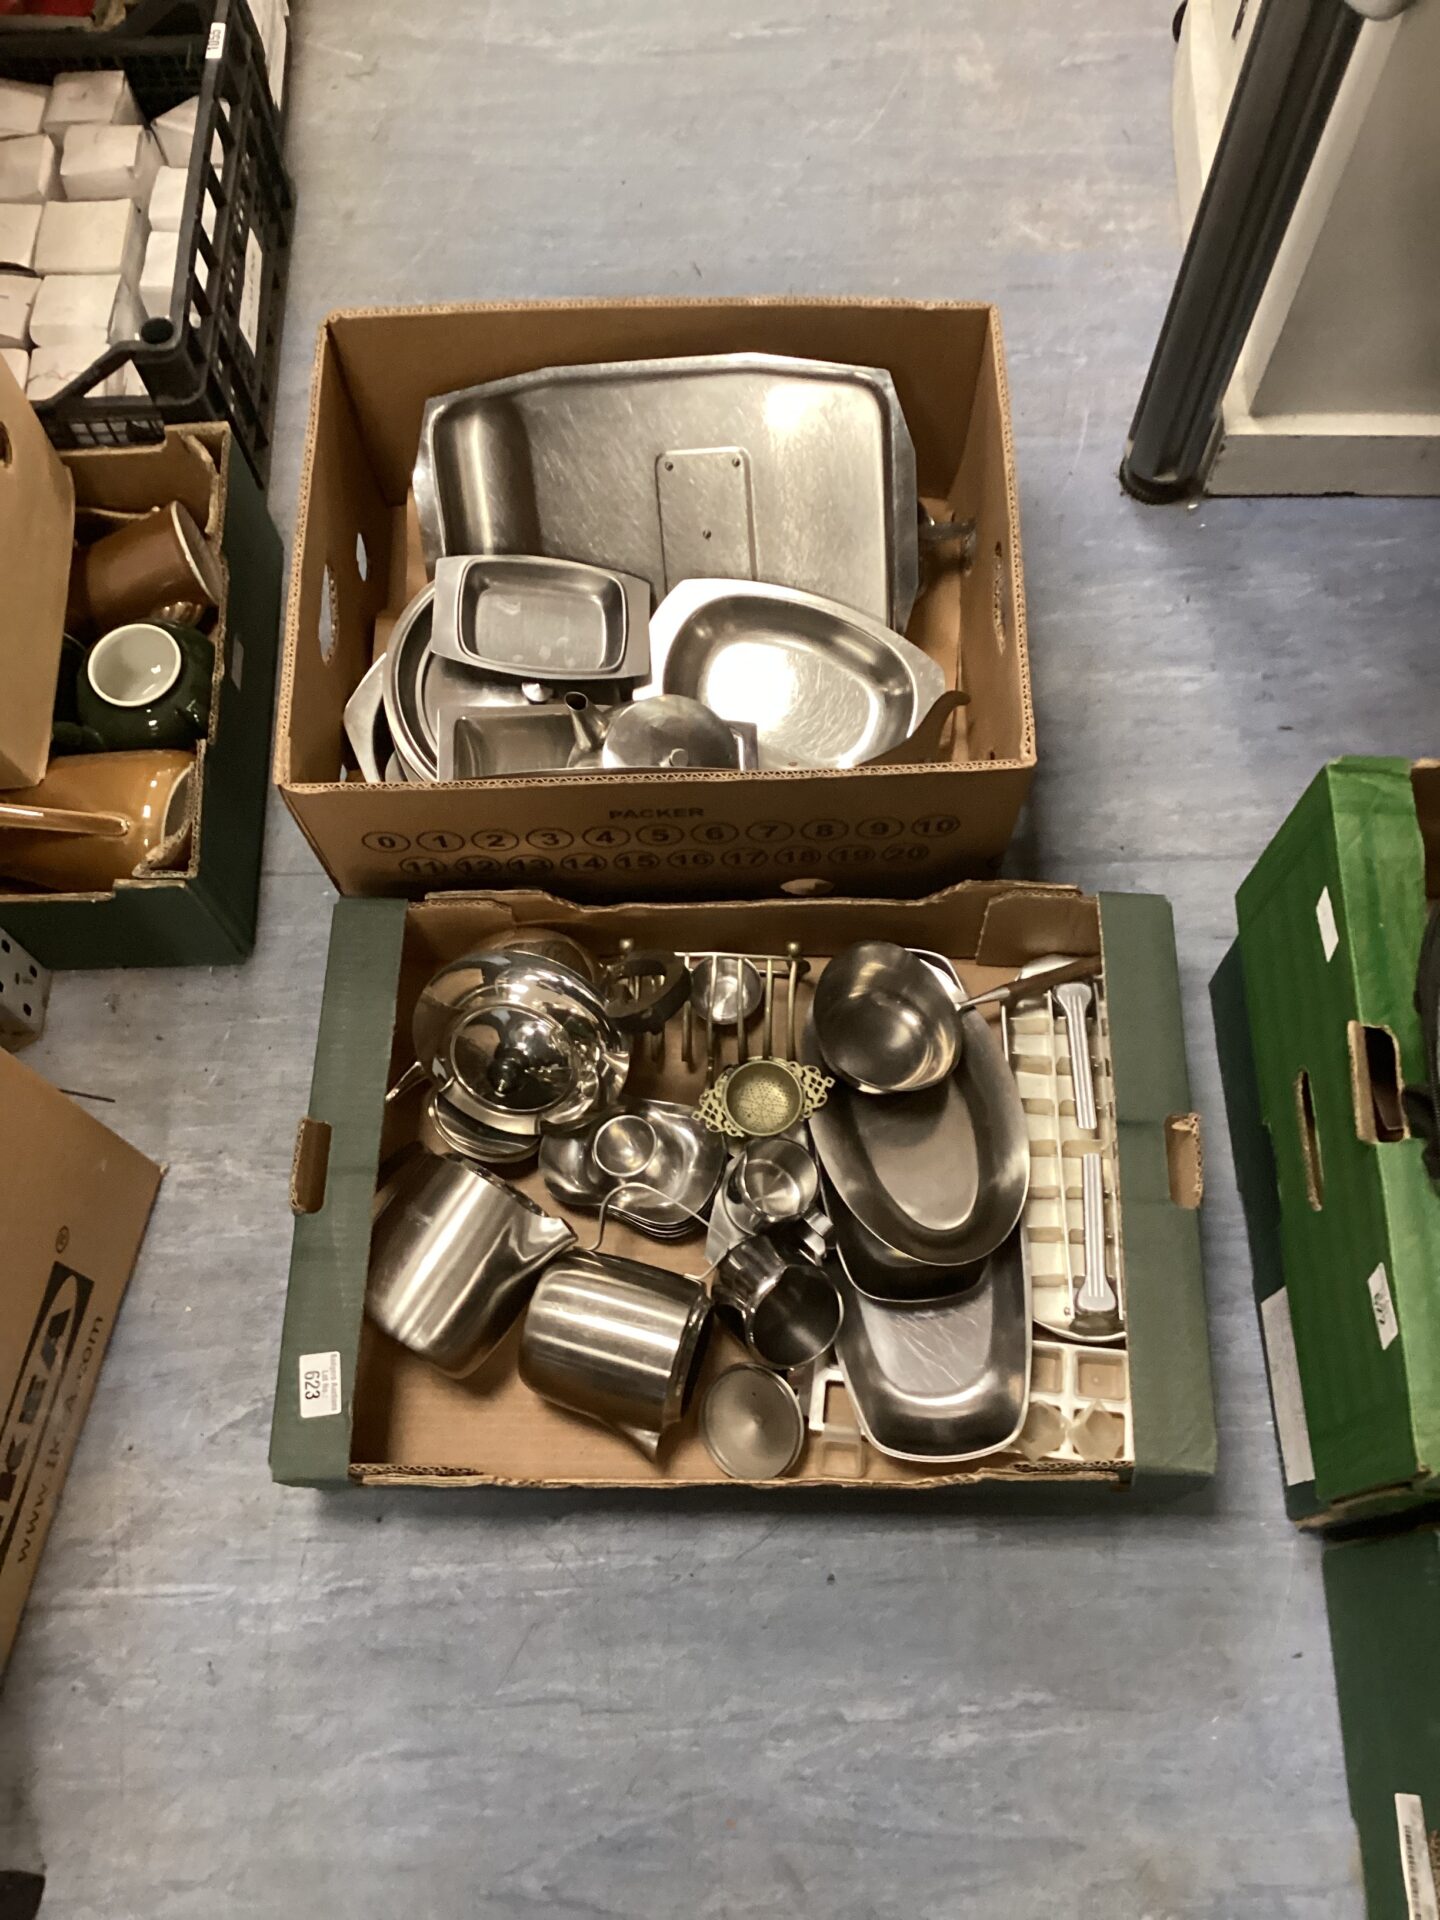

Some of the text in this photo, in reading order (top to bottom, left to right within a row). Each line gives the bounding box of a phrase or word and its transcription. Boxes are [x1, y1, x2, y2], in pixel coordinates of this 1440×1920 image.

[608, 808, 705, 819] PACKER
[378, 819, 955, 848] 0 1 2 3 4 5 6 7 8 9 10
[406, 847, 924, 873] 11 12 13 14 15 16 17 18 19 20
[304, 1370, 320, 1400] 623
[0, 1308, 72, 1531] KEA
